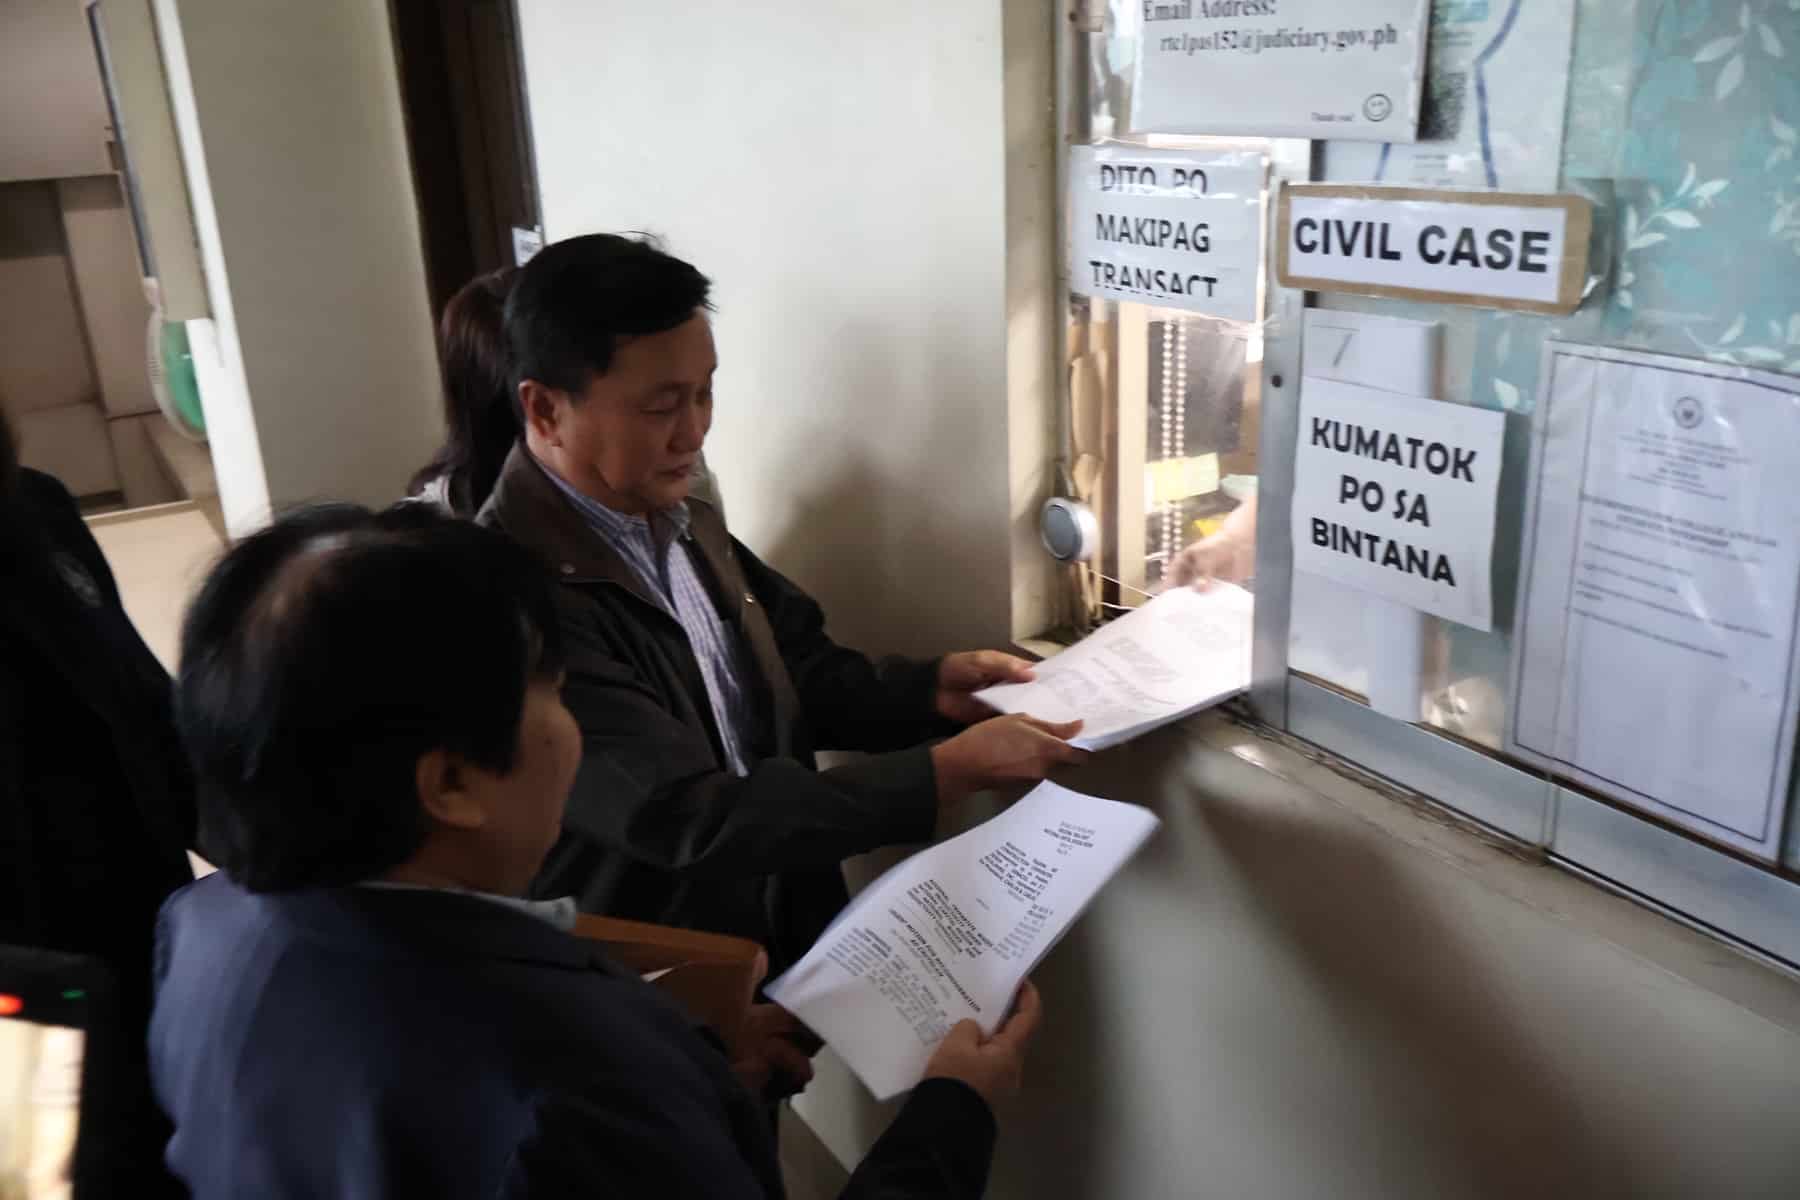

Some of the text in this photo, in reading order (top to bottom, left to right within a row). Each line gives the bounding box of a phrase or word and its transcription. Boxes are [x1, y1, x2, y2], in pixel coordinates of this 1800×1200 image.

[1100, 164, 1208, 199] DITO PO
[1096, 212, 1210, 253] MAKIPAG
[1294, 217, 1551, 273] CIVIL CASE
[1089, 260, 1218, 298] TRANSACT
[1311, 416, 1478, 483] KUMATOK
[1339, 474, 1431, 528] PO SA
[1311, 516, 1457, 588] BINTANA
